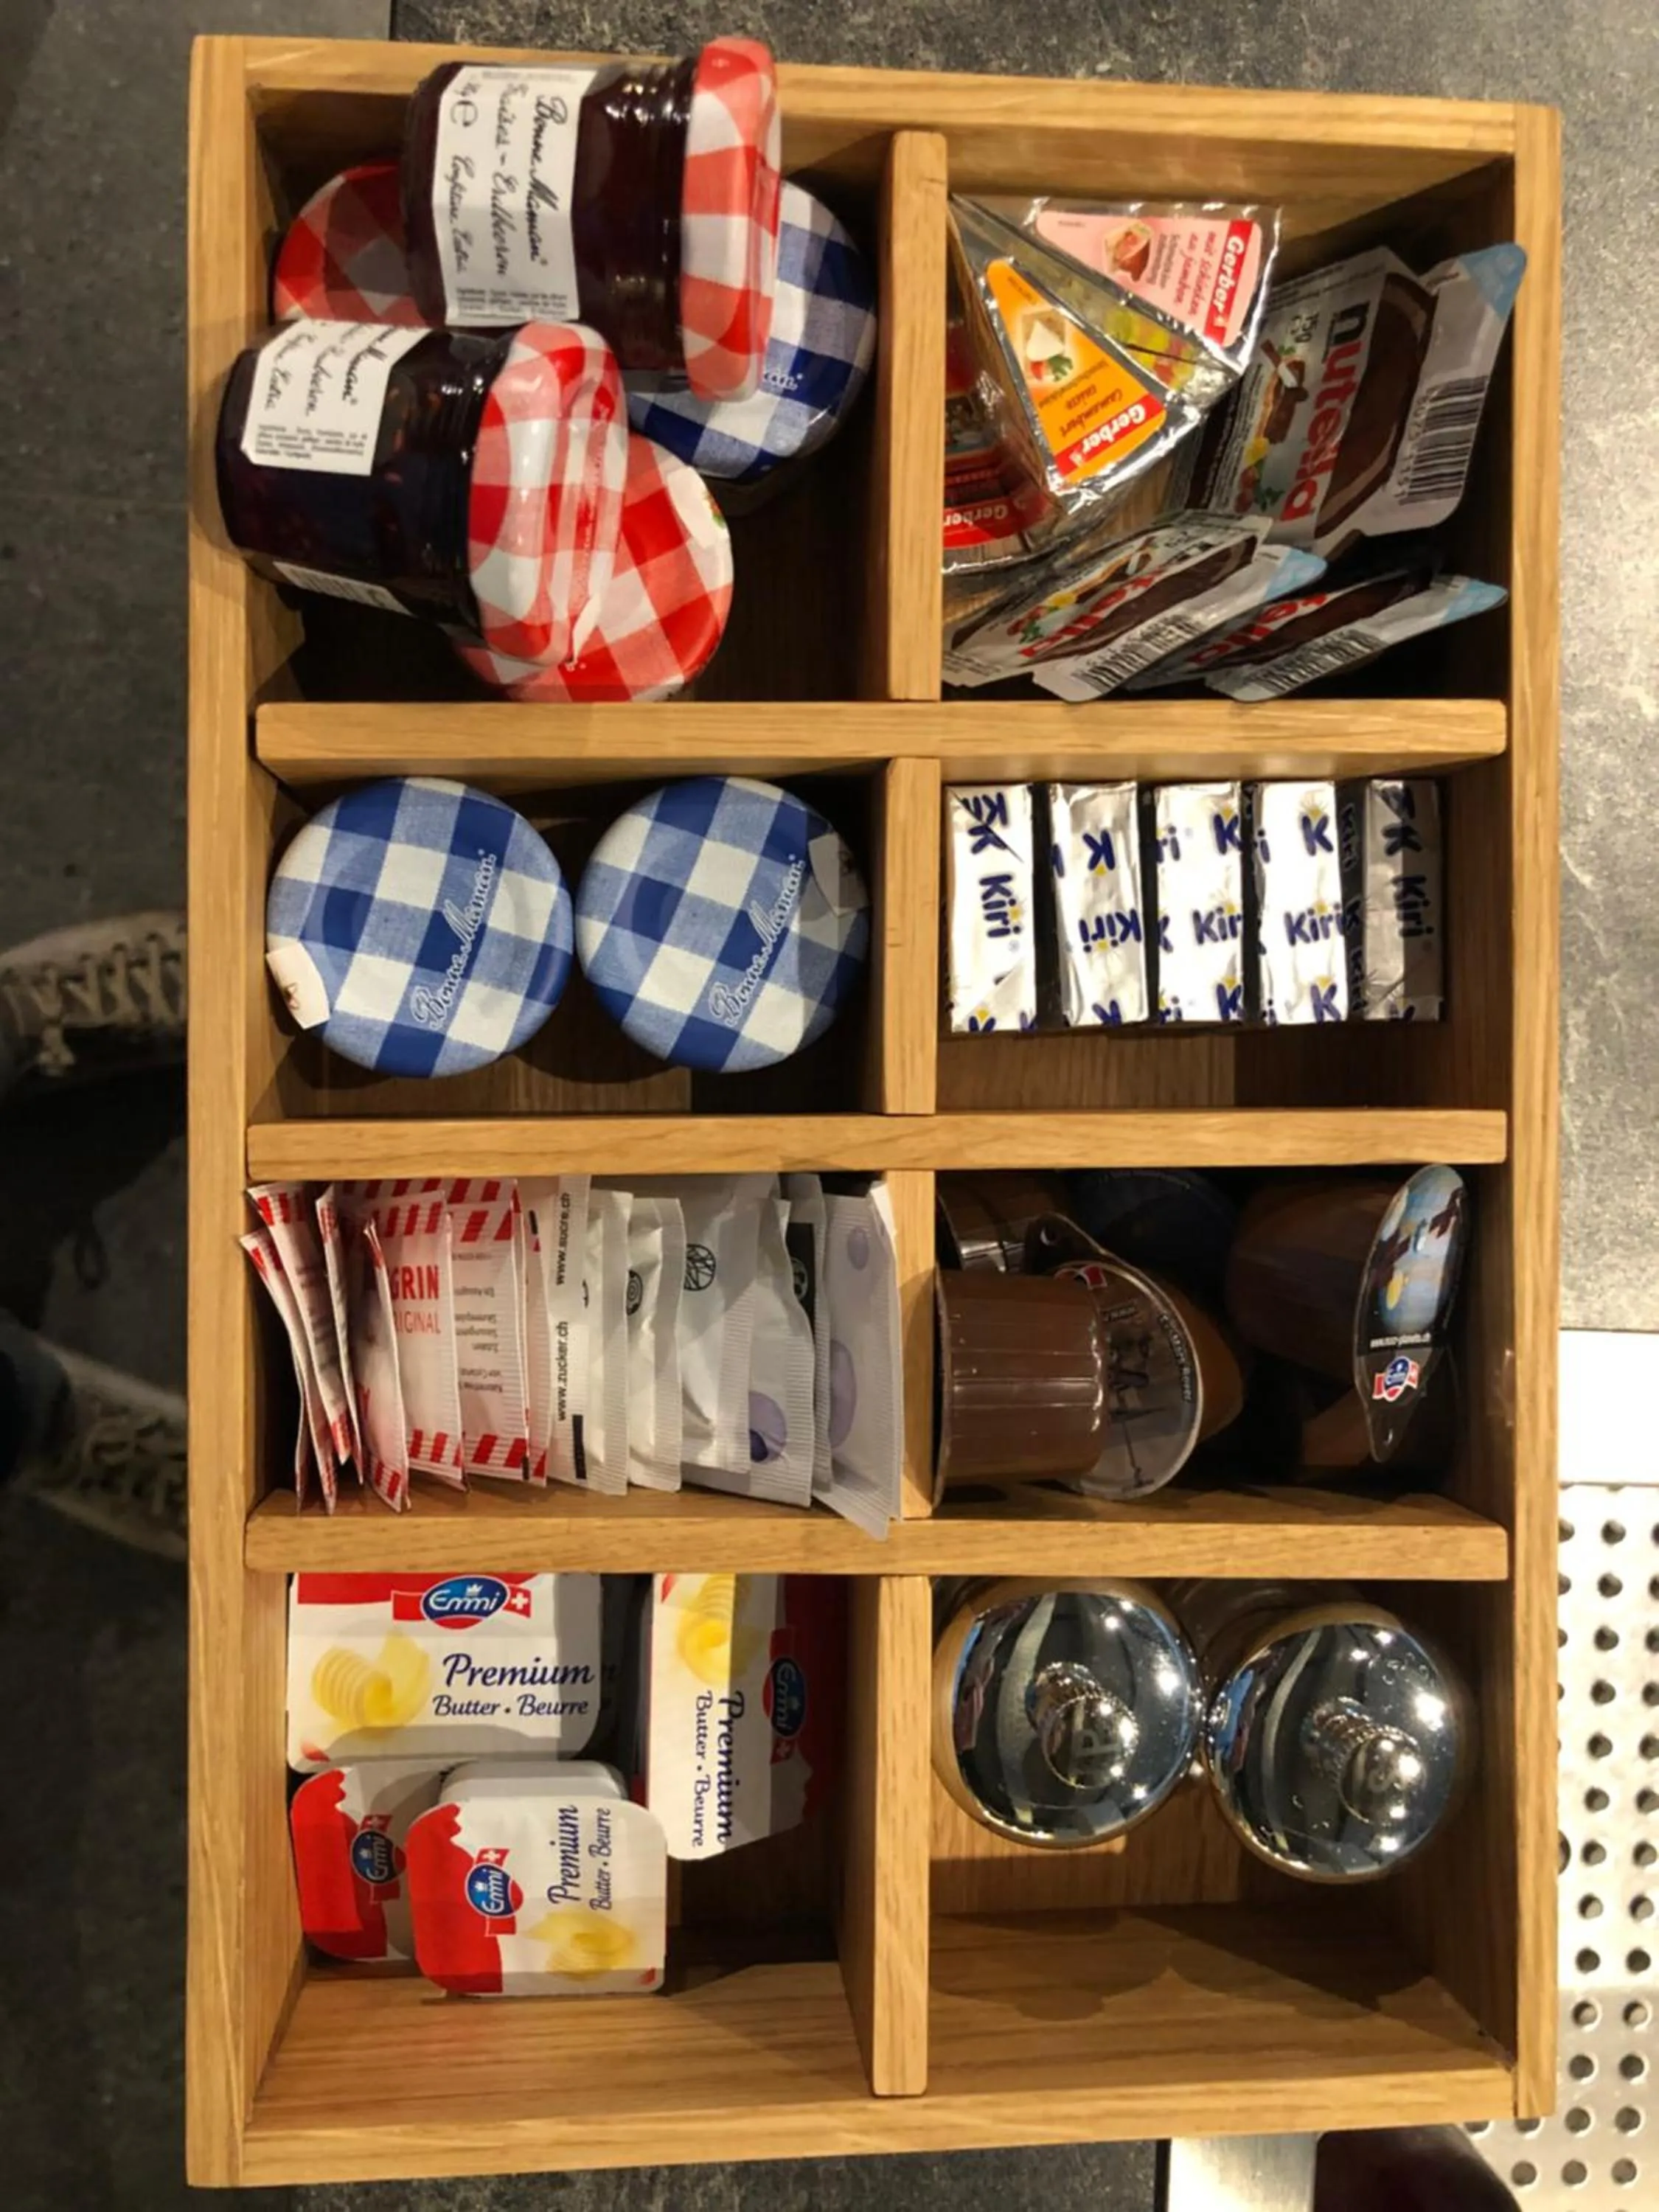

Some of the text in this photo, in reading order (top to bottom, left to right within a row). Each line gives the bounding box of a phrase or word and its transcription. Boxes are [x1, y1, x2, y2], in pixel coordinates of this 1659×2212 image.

[524, 95, 568, 262] Bonne Maman
[1213, 235, 1245, 313] Gerber
[1059, 388, 1123, 438] Camembert
[1082, 403, 1146, 453] Gerber
[1280, 300, 1371, 524] nutella
[942, 504, 1009, 526] Gerber
[409, 849, 497, 1029] Bonne Maman
[978, 874, 1021, 939] Kiri
[1078, 908, 1142, 953] Kiri
[1192, 906, 1243, 946] Kir
[1284, 902, 1346, 947] Kiri
[1391, 874, 1435, 939] Kiri
[707, 855, 806, 1027] Bonne Maman
[554, 1192, 572, 1287] www.sucre.ch
[389, 1264, 440, 1301] GRIN
[393, 1310, 442, 1335] RIGINAL
[554, 1320, 570, 1422] www.zucker.ch
[428, 1587, 501, 1613] Emmi
[442, 1653, 595, 1688] Premium
[776, 1660, 797, 1731] Emmi
[432, 1694, 589, 1717] Butter Beurre
[691, 1689, 713, 1847] Butter Beurre
[717, 1690, 745, 1845] Premium
[366, 1835, 389, 1881] Emmi
[547, 1804, 581, 1905] Premium
[588, 1807, 612, 1911] Butter Beurre
[480, 1869, 506, 1914] Emmi
